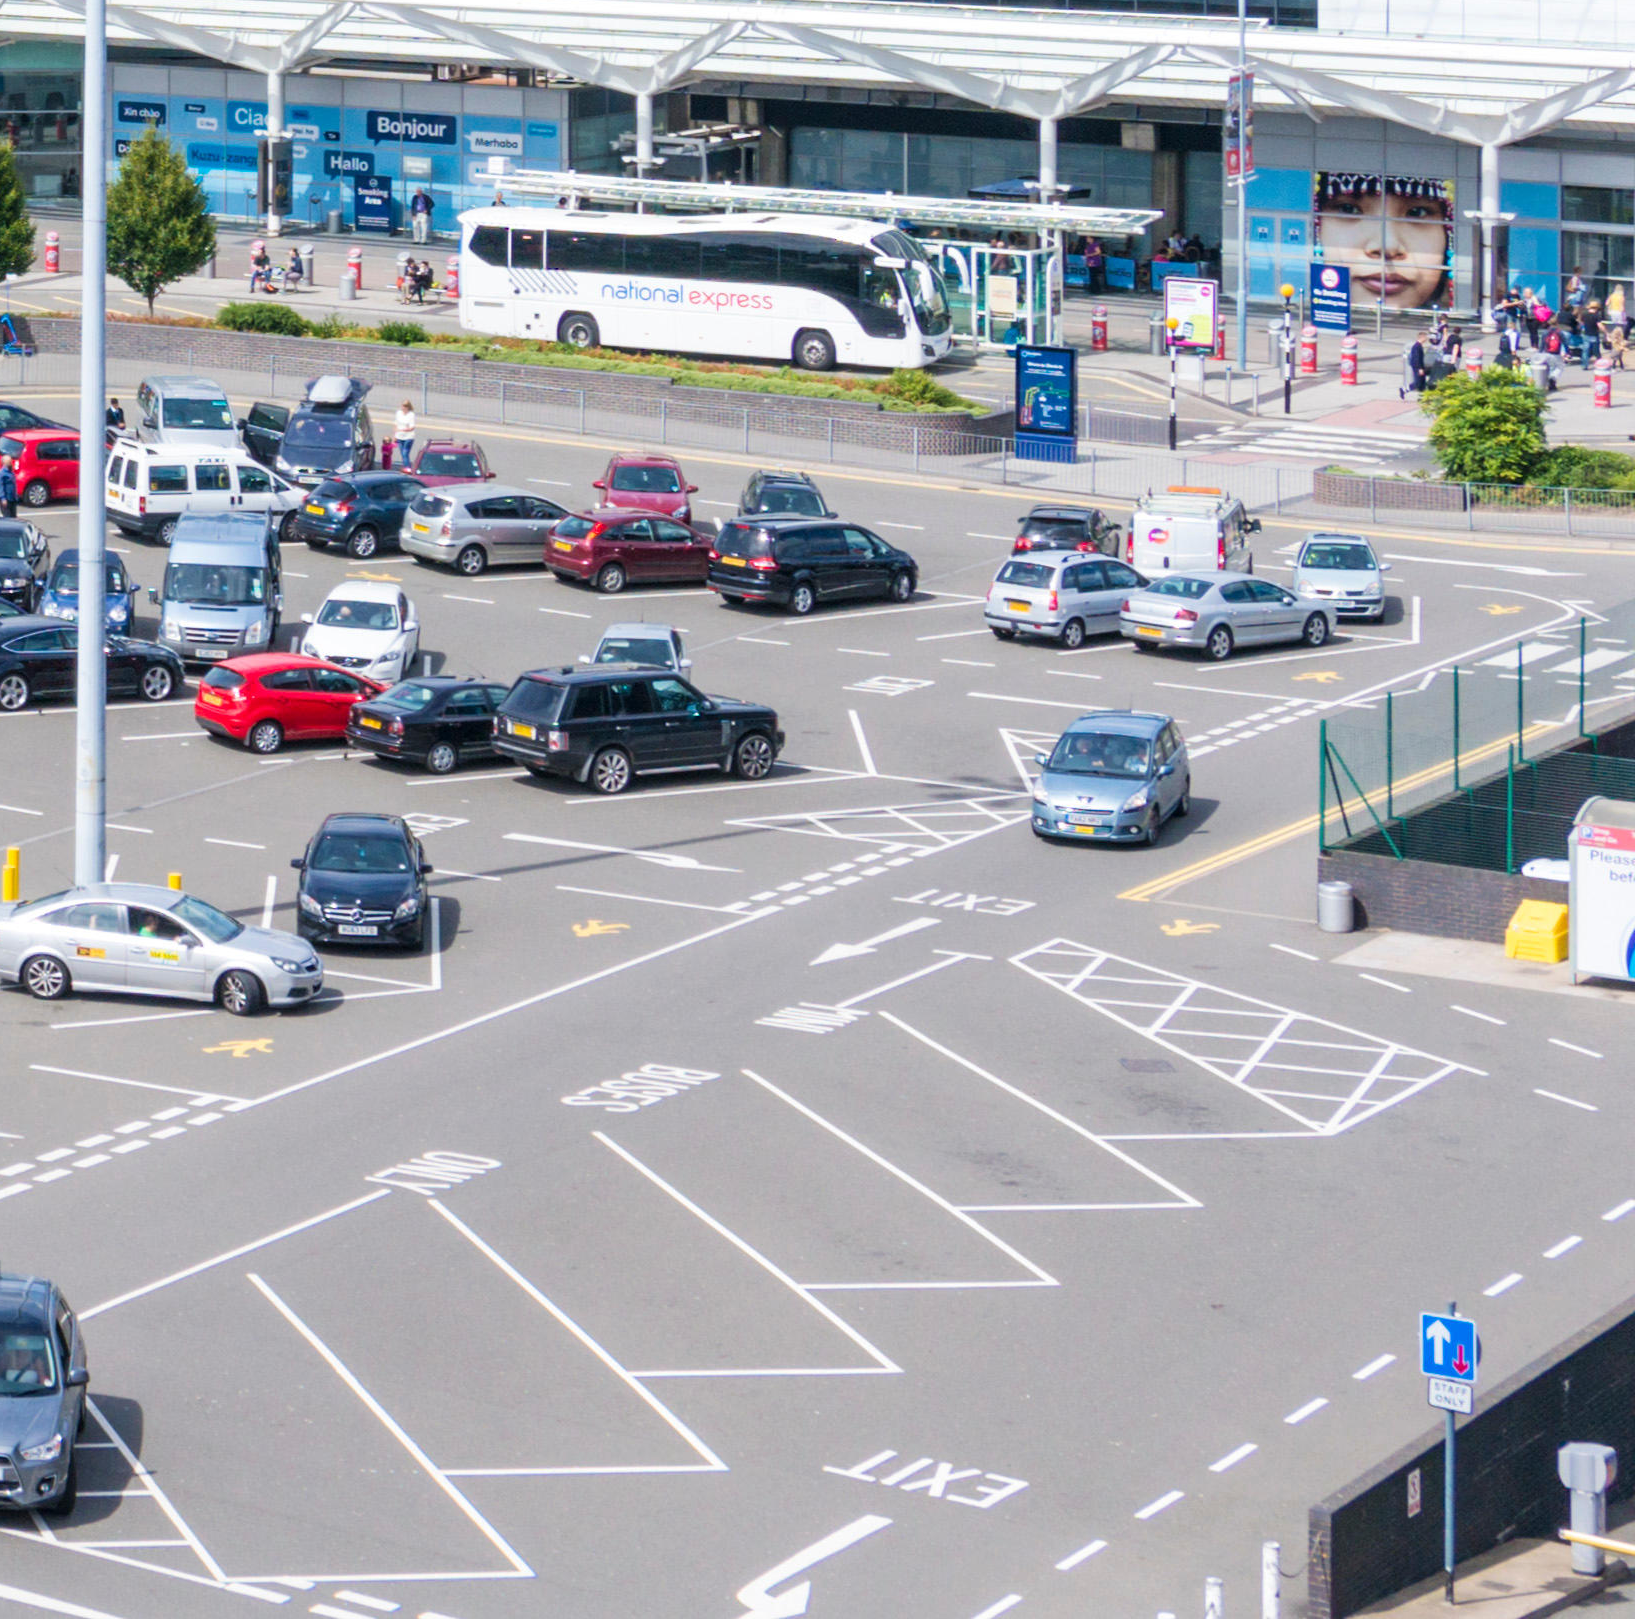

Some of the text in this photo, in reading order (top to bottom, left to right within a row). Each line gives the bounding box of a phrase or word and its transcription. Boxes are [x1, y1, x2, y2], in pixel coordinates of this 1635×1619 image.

[123, 107, 137, 117] Xin
[377, 116, 447, 139] Bonjour
[475, 137, 518, 149] Merhaba
[330, 155, 369, 172] Hallo
[358, 188, 389, 198] Smoking
[364, 197, 382, 205] Area
[601, 280, 773, 312] national express
[892, 888, 1037, 916] EXIT
[560, 1063, 721, 1113] BUSES
[364, 1150, 502, 1196] ONLY
[1434, 1381, 1467, 1396] STAFF
[1434, 1395, 1466, 1408] ONLY
[822, 1449, 1030, 1509] EXIT
